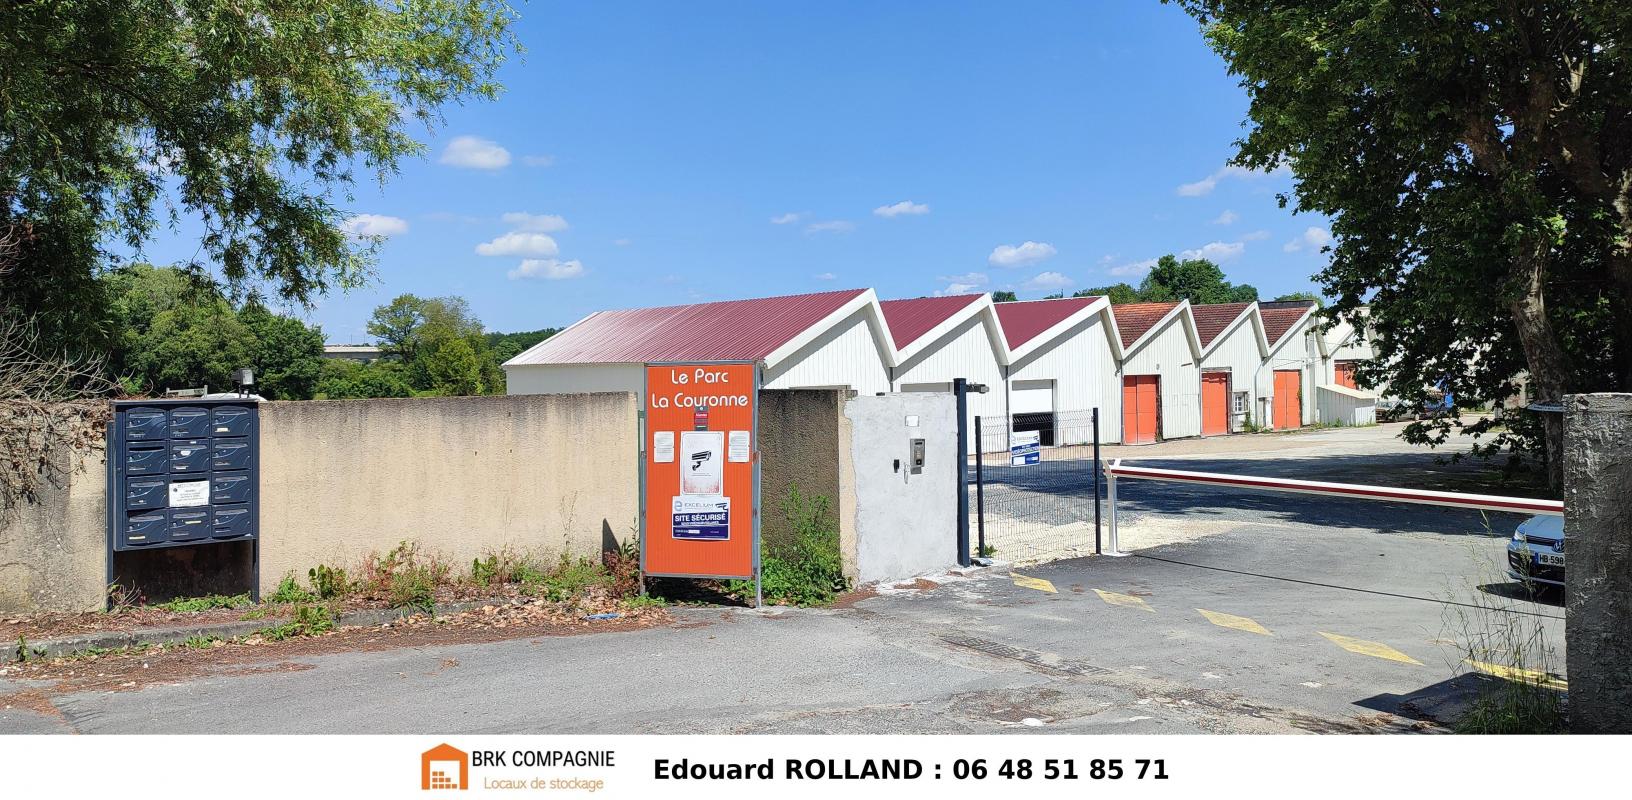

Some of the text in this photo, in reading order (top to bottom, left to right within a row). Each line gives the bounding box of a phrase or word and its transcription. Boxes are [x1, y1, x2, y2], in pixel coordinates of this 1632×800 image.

[671, 368, 729, 384] Le Parc
[652, 392, 748, 408] La Couronne
[674, 512, 726, 522] SITE SÉCURISÉ
